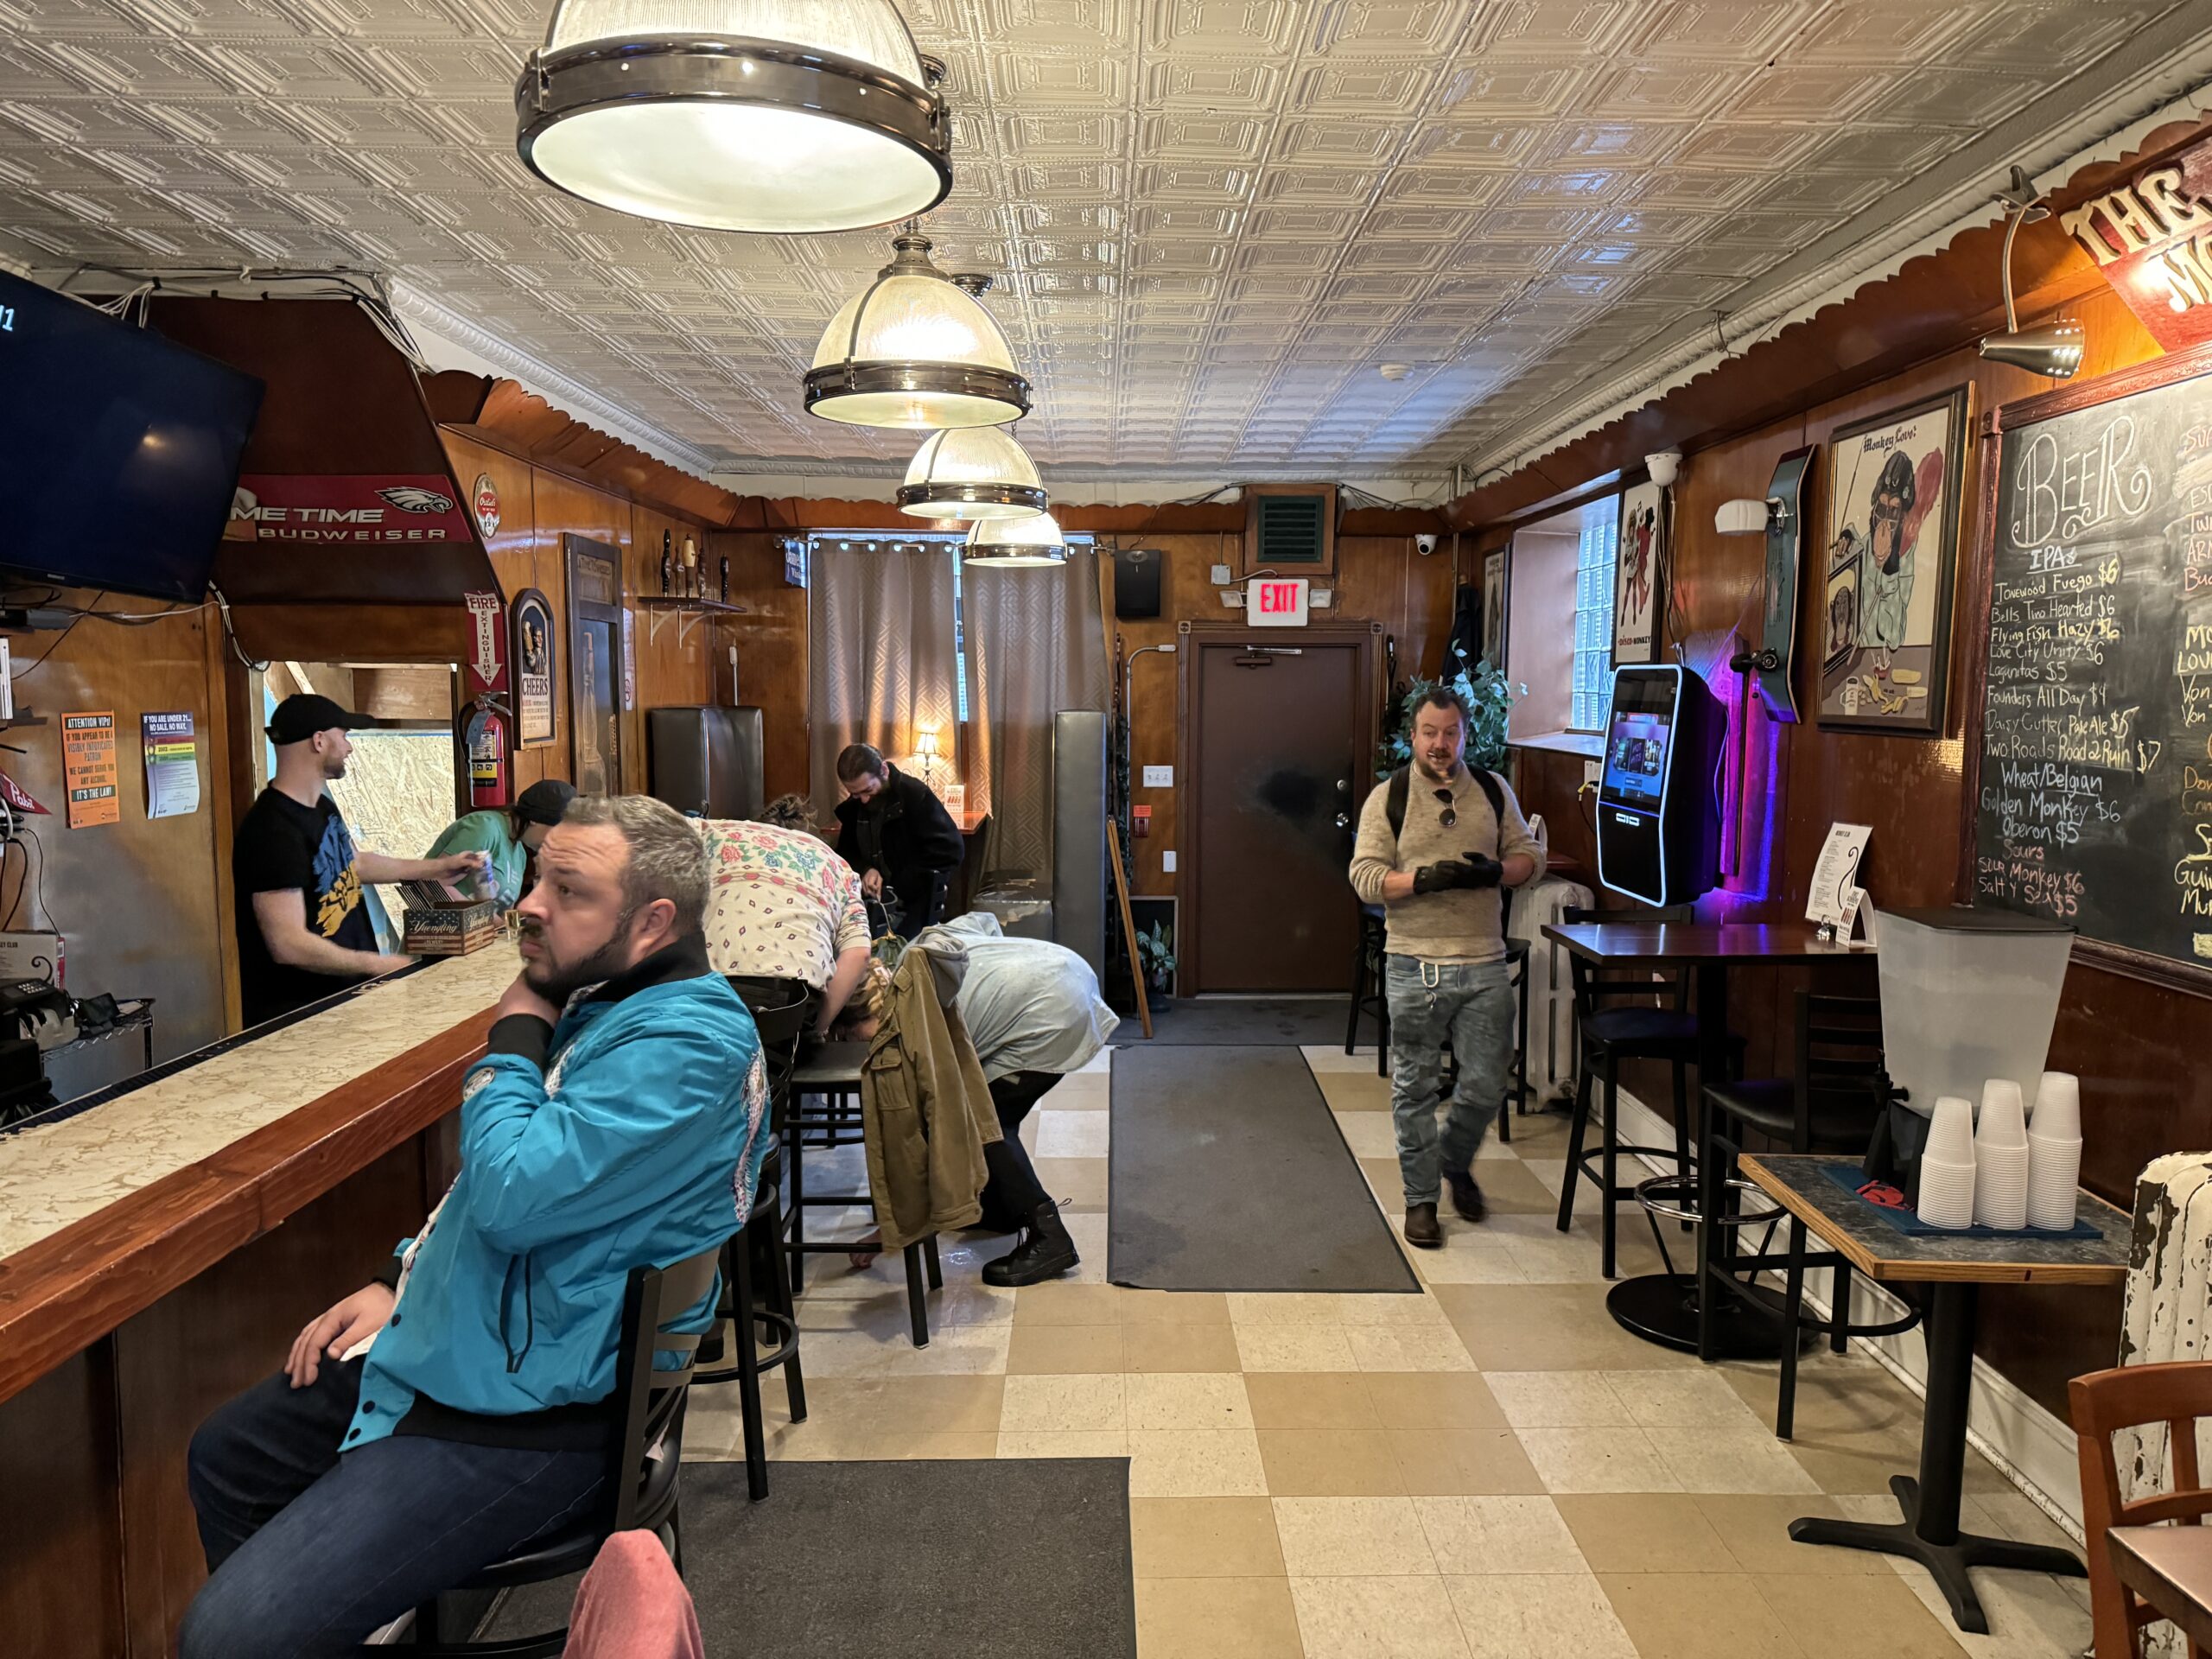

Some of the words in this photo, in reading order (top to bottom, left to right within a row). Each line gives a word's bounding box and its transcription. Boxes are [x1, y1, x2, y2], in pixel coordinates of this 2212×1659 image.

[1864, 434, 1894, 458] Monkey
[2012, 416, 2152, 548] BEER
[293, 508, 385, 523] TIME
[258, 528, 446, 540] BUDWEISER
[2053, 574, 2092, 593] Fuego
[469, 597, 497, 609] FIRE
[1260, 583, 1299, 613] EXIT
[2050, 593, 2093, 618] Hearted
[2098, 594, 2114, 617] $6
[1991, 626, 2024, 646] Flying
[2027, 625, 2050, 642] Fish
[2058, 619, 2094, 645] Hazy
[480, 610, 492, 681] EXTINGUISHER
[2016, 643, 2039, 663] City
[2044, 642, 2080, 662] Unity
[2045, 661, 2068, 682] $5
[523, 678, 549, 696] CHEERS
[1987, 685, 2031, 708] Founders
[2037, 685, 2055, 708] All
[2059, 687, 2086, 716] Day
[2088, 682, 2107, 707] $4
[2180, 673, 2209, 703] Von
[68, 717, 97, 728] ATTENTION
[1985, 709, 2019, 731] Daisy
[2021, 713, 2062, 735] Cutter
[2069, 715, 2088, 735] Pale
[2089, 715, 2107, 734] Ale
[2181, 703, 2205, 728] Von
[82, 732, 98, 741] APPEAR
[1985, 734, 2008, 757] Two
[2012, 735, 2055, 759] Roads
[2058, 735, 2087, 760] Road
[2088, 741, 2101, 760] 2
[2102, 740, 2130, 767] Ruin
[2137, 740, 2161, 773] $7
[78, 766, 93, 774] CANNOT
[2001, 761, 2102, 796] Wheat/Belgian
[77, 788, 87, 800] IT'S
[89, 787, 99, 798] THE
[100, 786, 111, 797] LAW!
[1981, 787, 2023, 817] Golden
[2030, 791, 2089, 827] Monkey
[2094, 797, 2120, 822] $6
[2003, 815, 2052, 843] Oberon
[2056, 822, 2082, 849] $5
[2002, 839, 2044, 861] Sours
[2010, 863, 2061, 893] Monkey
[2053, 892, 2078, 918] $5
[410, 919, 459, 933] Yuengling
